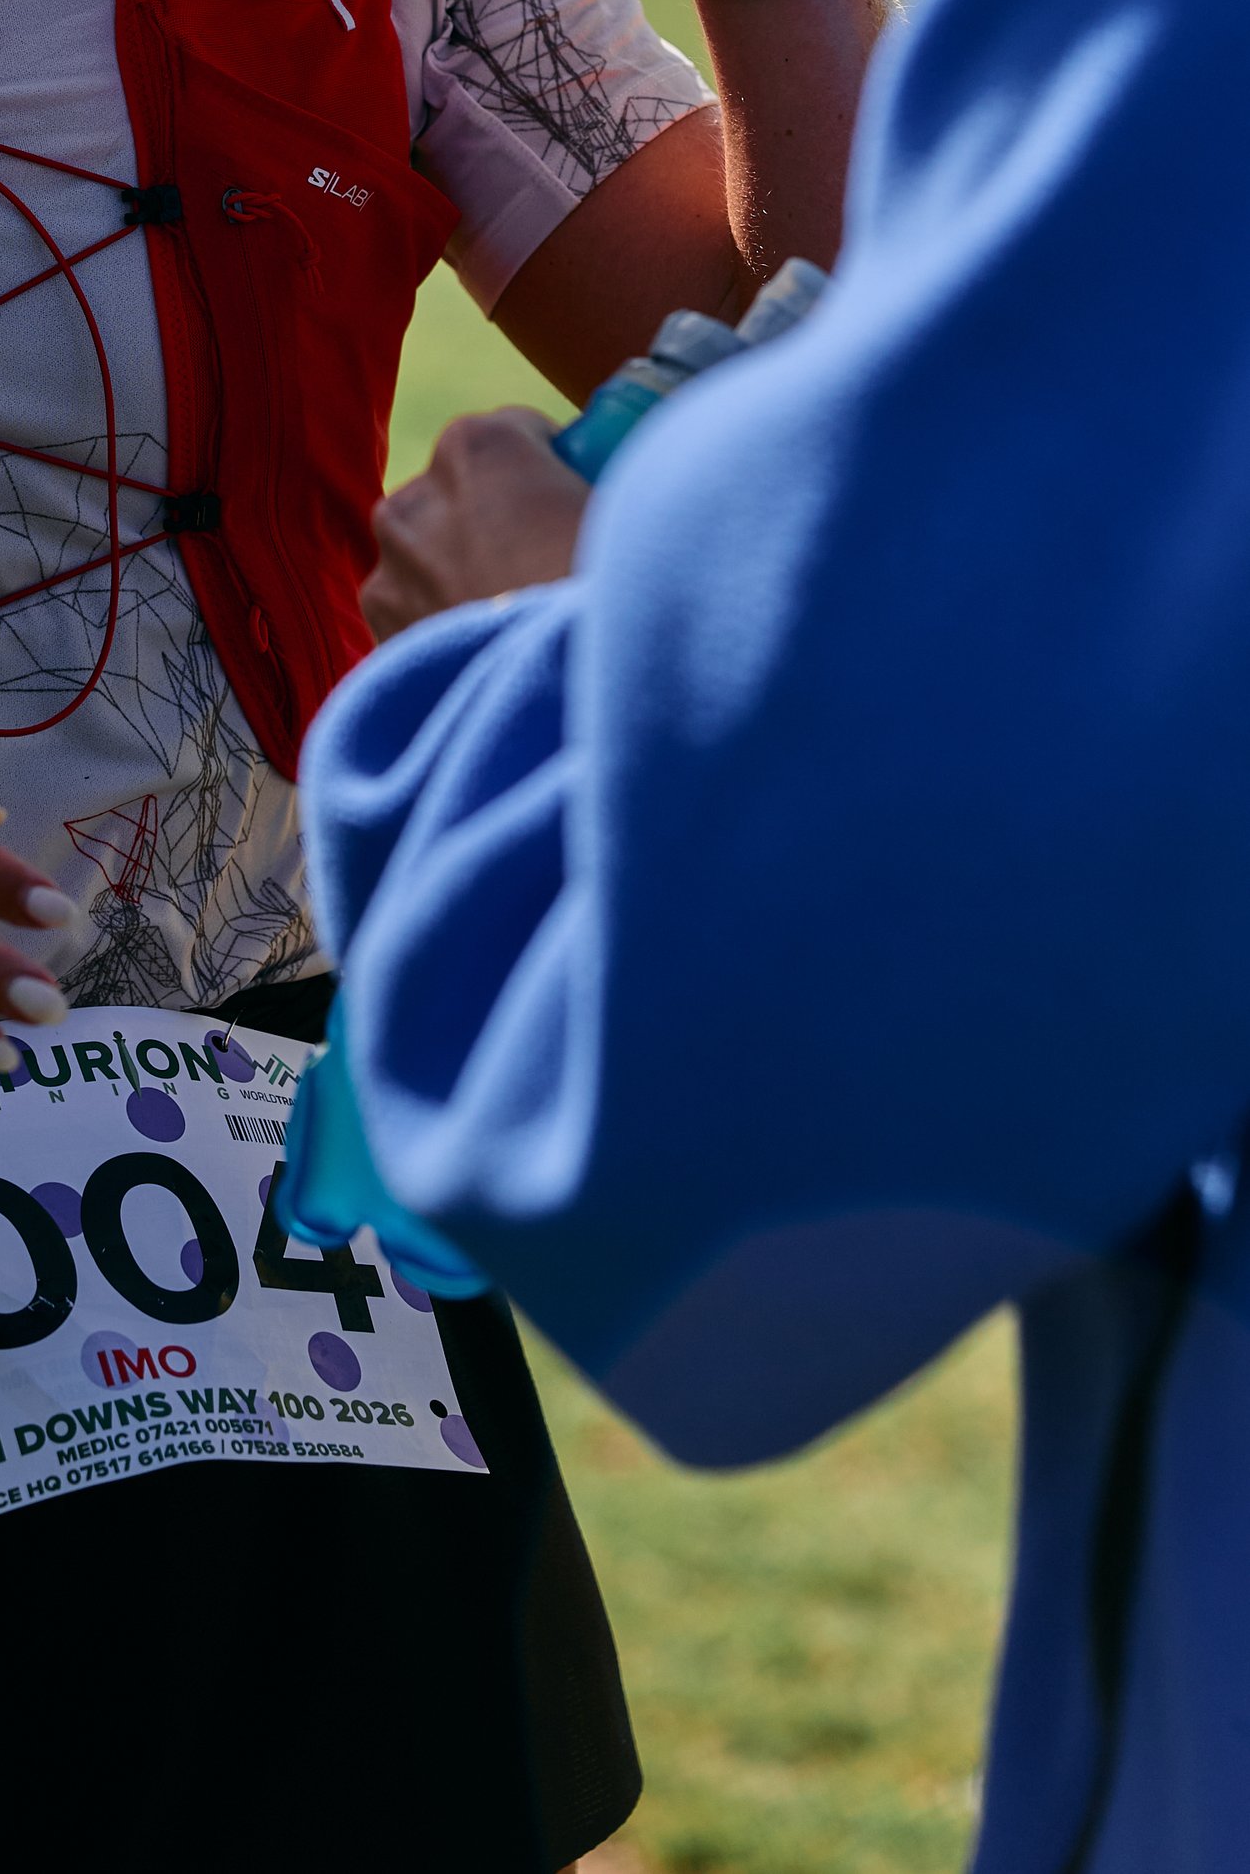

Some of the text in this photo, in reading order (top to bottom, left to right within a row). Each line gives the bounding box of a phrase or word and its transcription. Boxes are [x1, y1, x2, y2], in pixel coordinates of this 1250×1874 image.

[240, 1089, 296, 1107] WORLDTRA
[97, 1345, 197, 1388] IMO
[14, 1392, 172, 1456] DOWNS
[176, 1388, 257, 1416] WAY
[268, 1391, 325, 1421] 100
[330, 1397, 415, 1427] 2026
[56, 1419, 274, 1466] MEDIC 07421 005671
[26, 1475, 62, 1499] HQ
[66, 1455, 131, 1486] 07517
[138, 1439, 215, 1468] 614166
[231, 1440, 290, 1457] 07528
[293, 1442, 365, 1458] 520584
